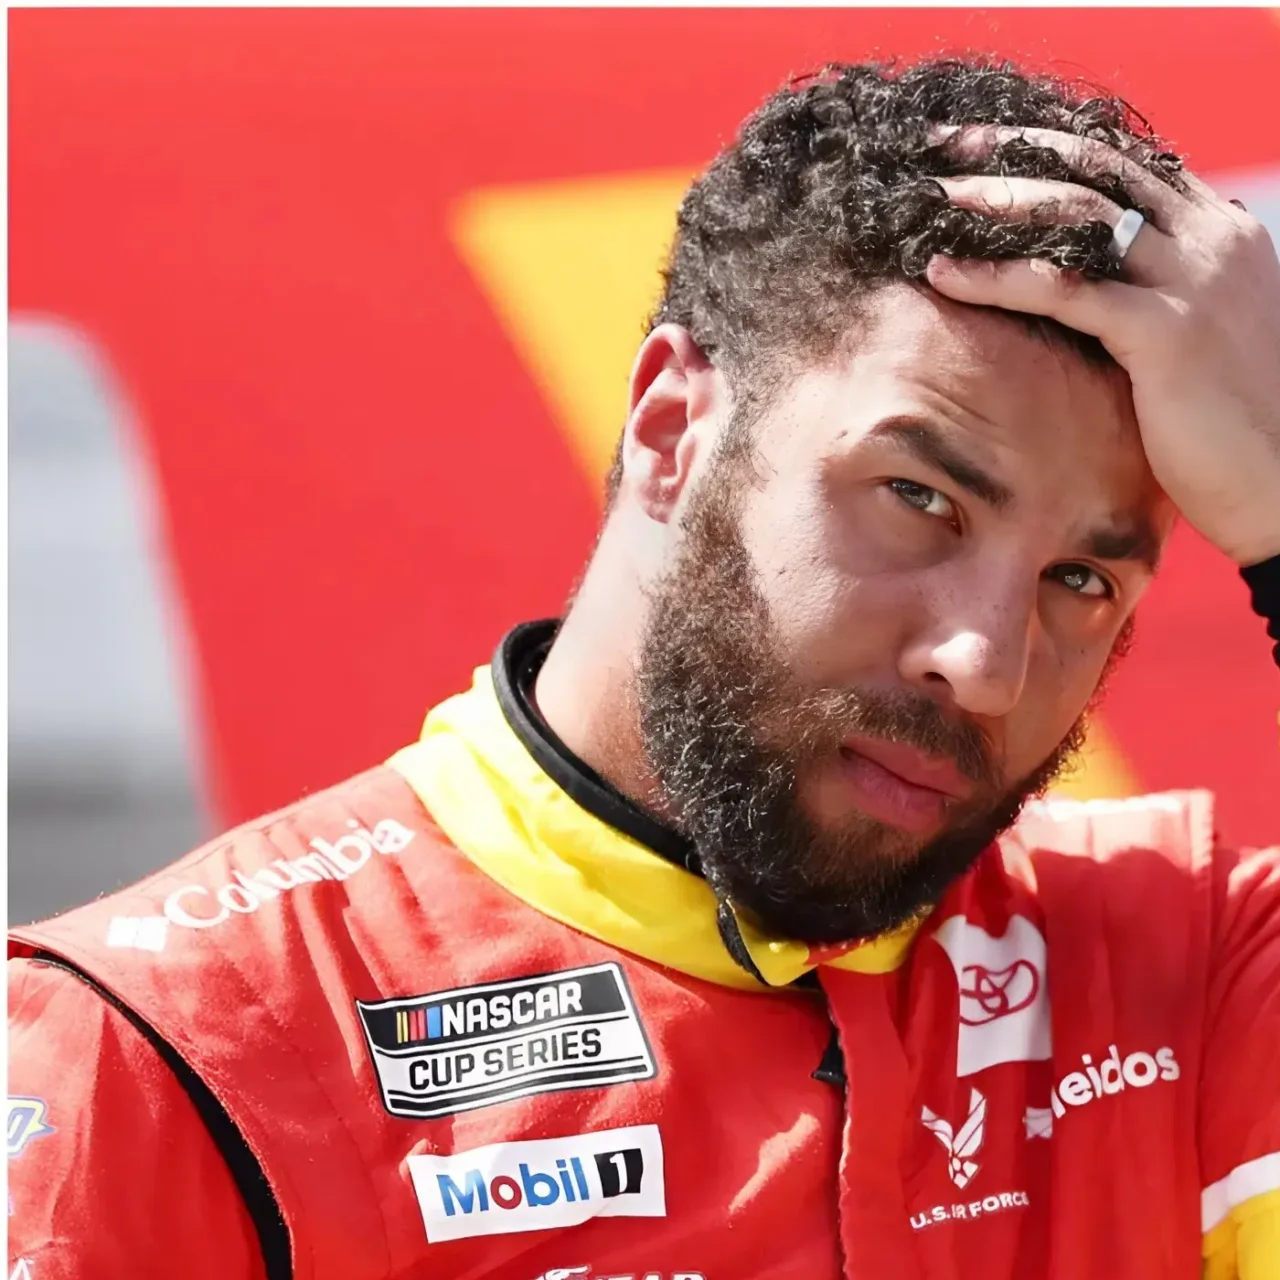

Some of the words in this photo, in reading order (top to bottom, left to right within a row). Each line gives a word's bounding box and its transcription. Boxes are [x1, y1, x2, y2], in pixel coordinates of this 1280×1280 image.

[440, 981, 583, 1037] NASCAR
[408, 1053, 476, 1091] CUP
[484, 1028, 602, 1077] SERIES
[436, 1156, 590, 1217] Mobil
